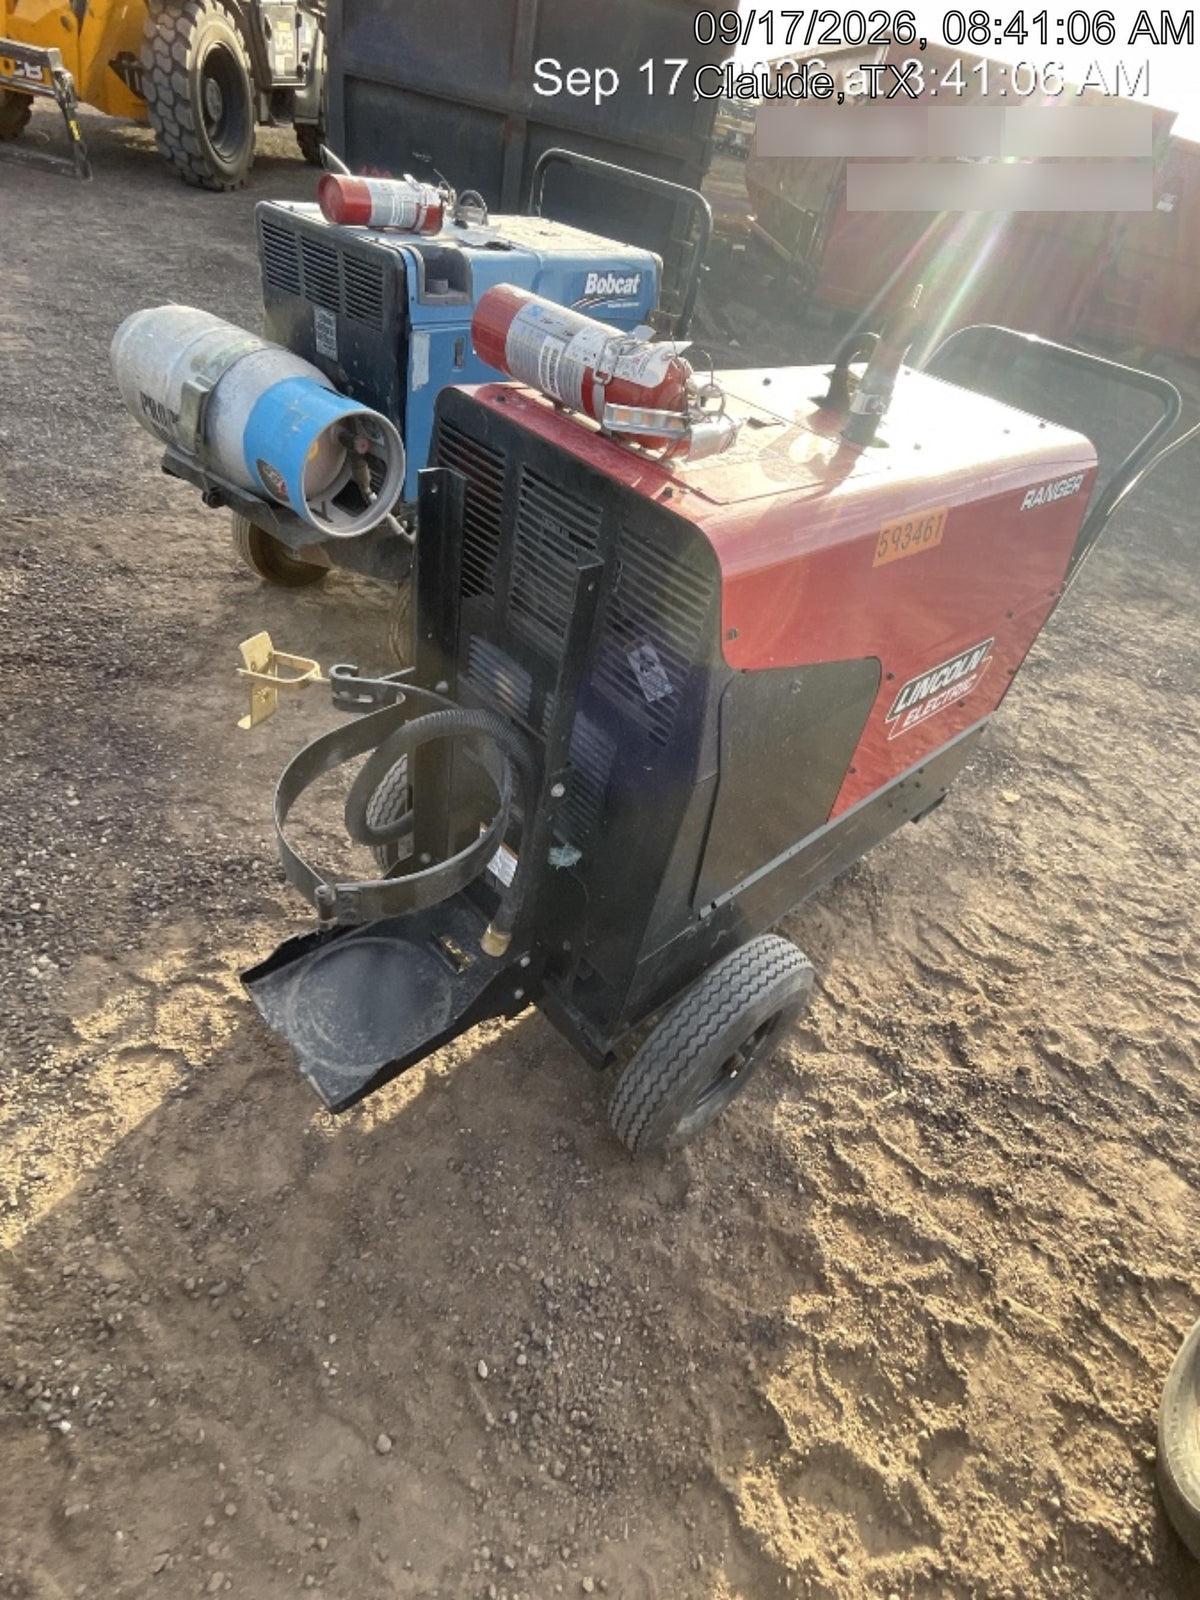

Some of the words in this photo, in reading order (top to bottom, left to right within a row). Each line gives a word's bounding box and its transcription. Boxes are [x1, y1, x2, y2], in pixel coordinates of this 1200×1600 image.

[584, 272, 641, 295] Bobcat
[1020, 474, 1084, 511] RANGER
[876, 513, 944, 558] 593461
[893, 646, 988, 715] LINCOLN
[902, 673, 977, 727] ELECTRIC
